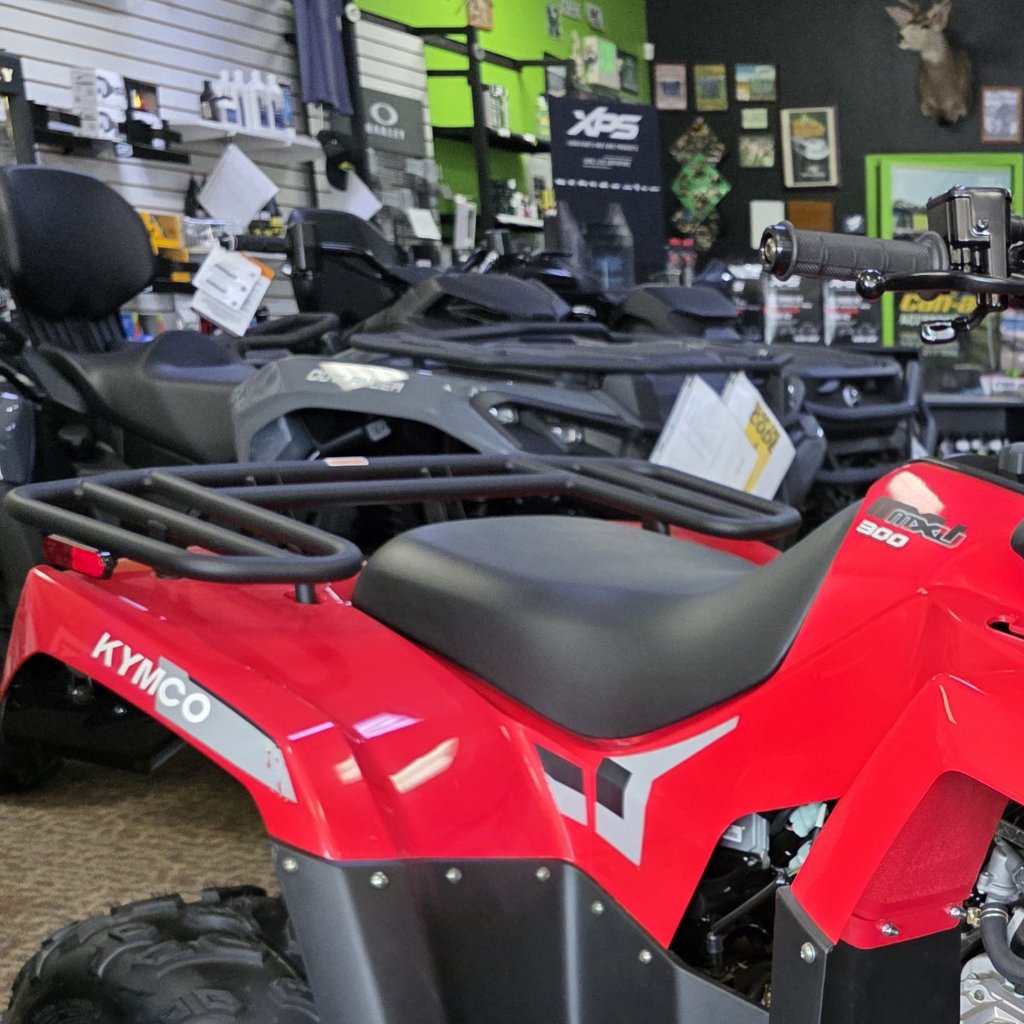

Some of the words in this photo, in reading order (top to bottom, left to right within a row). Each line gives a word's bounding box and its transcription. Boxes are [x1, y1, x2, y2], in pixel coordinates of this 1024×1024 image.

[566, 106, 643, 140] XPS
[856, 519, 910, 548] 300
[91, 632, 211, 723] KYMCO
